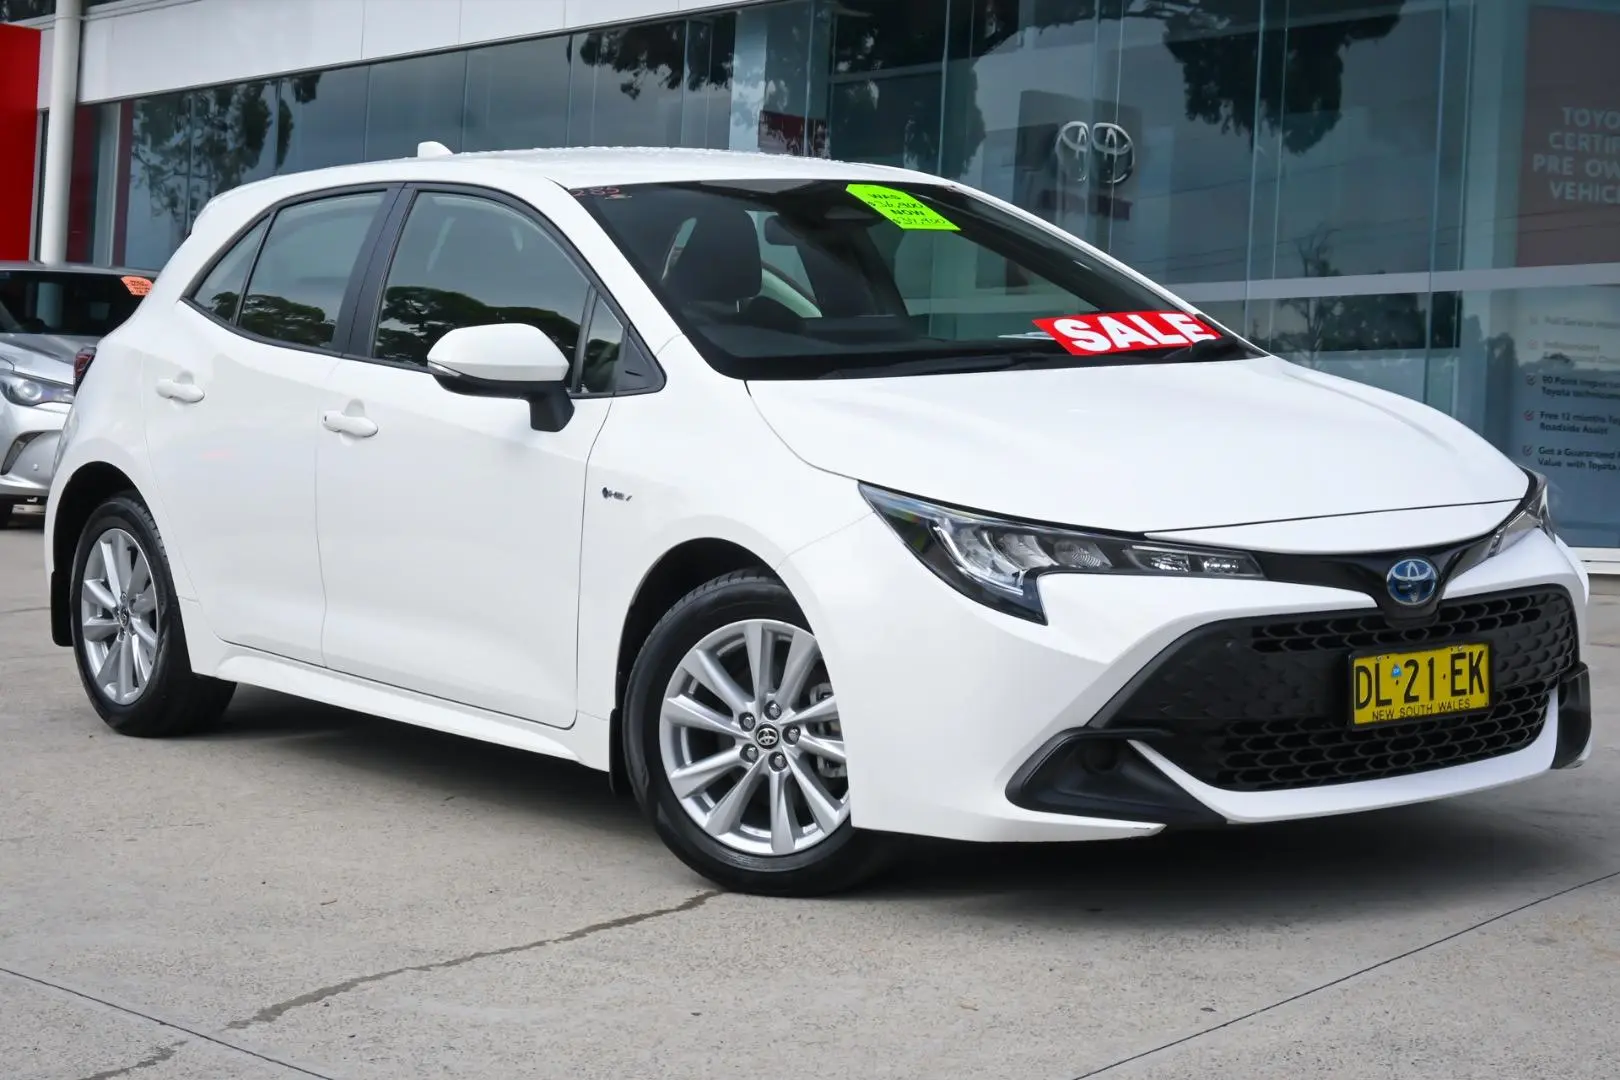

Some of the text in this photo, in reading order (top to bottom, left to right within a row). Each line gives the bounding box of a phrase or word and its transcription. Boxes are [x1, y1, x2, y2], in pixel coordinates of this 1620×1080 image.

[1532, 153, 1575, 176] PRE
[1053, 313, 1216, 352] SALE
[1542, 386, 1570, 397] Toyota
[1540, 411, 1559, 420] Free
[1561, 412, 1570, 421] 12
[1573, 413, 1606, 423] months
[1540, 422, 1609, 434] Roadside Assist
[1538, 447, 1555, 455] Get
[1538, 458, 1616, 472] Value with Toyota
[1372, 698, 1471, 721] NEW SOUTH WALES
